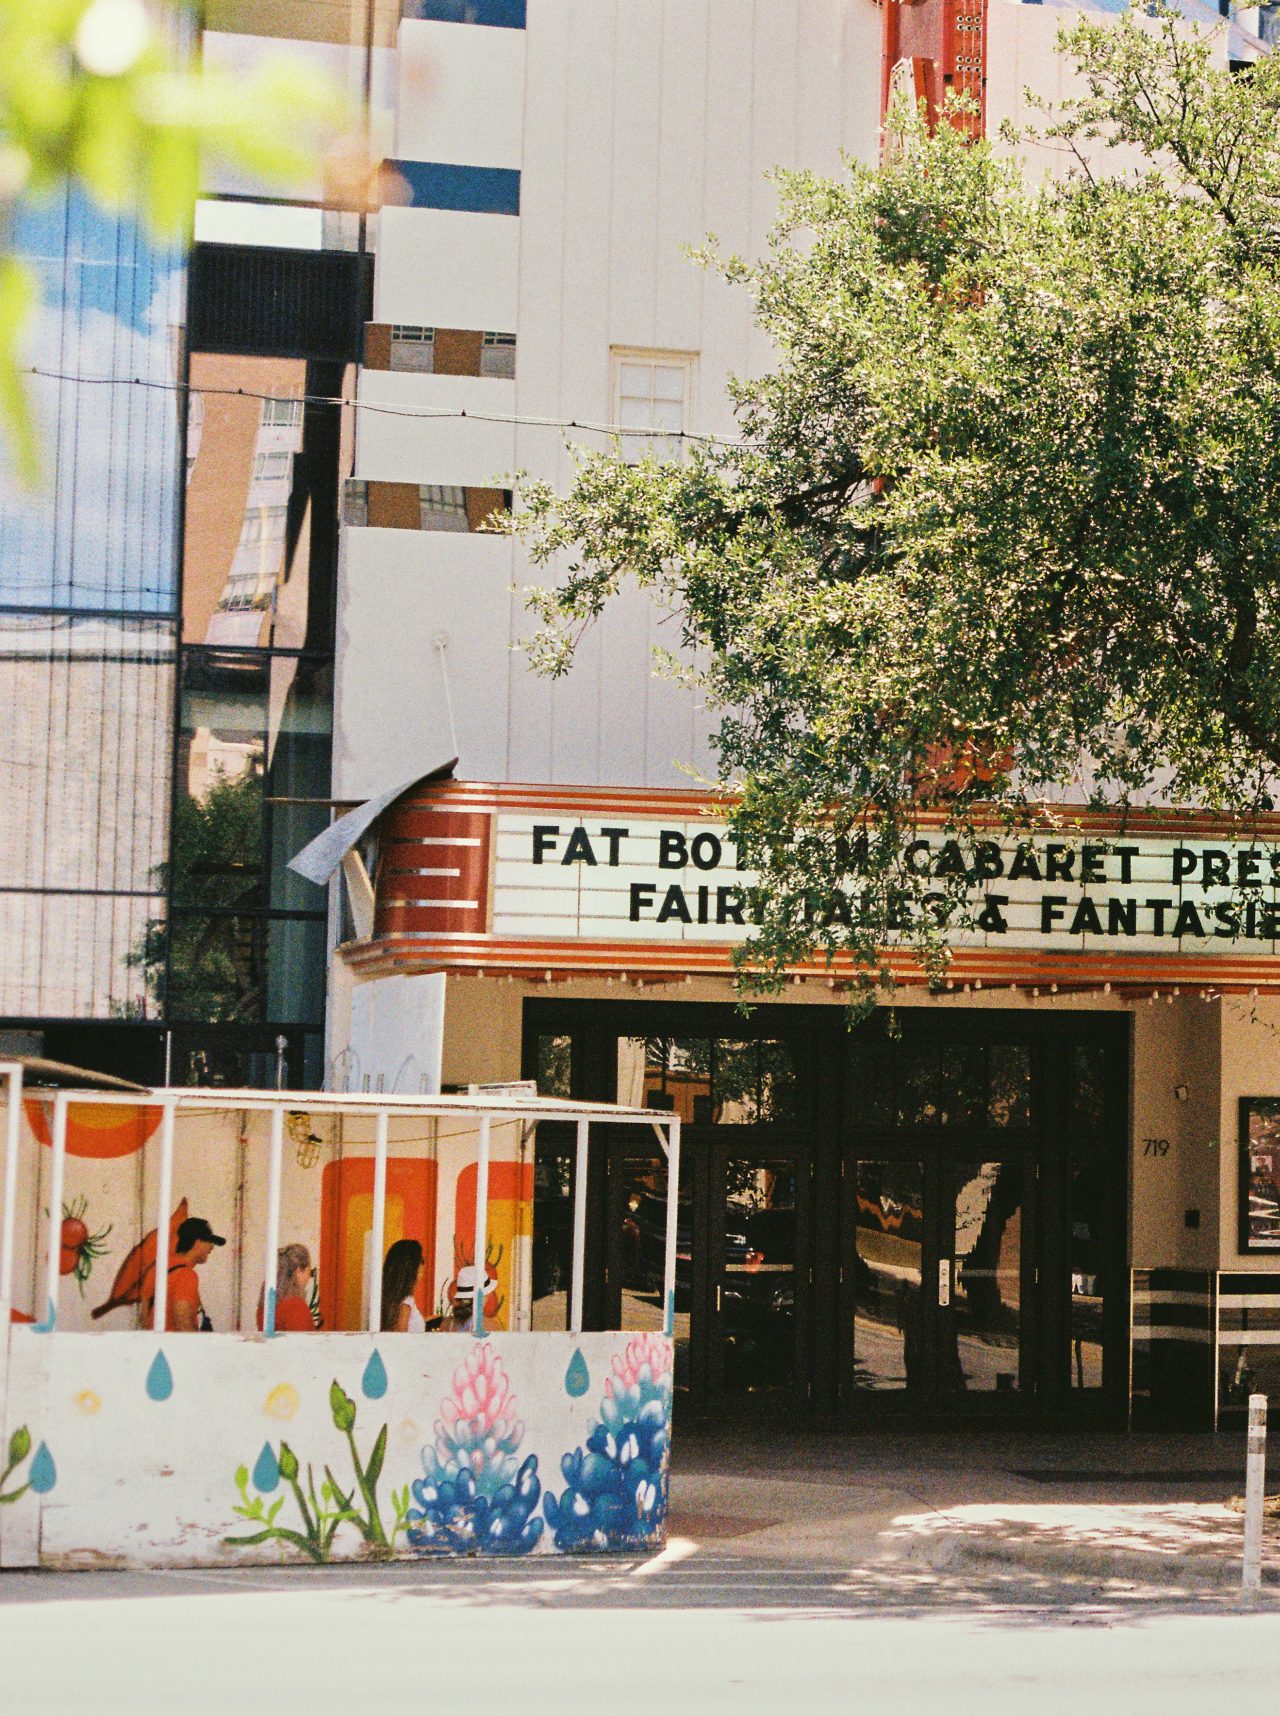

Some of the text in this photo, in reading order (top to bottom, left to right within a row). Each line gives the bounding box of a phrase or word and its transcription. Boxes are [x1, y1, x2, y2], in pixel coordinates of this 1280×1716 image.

[532, 825, 629, 866] FAT
[659, 830, 869, 876] BOTTM
[904, 839, 1139, 885] CABARET
[978, 895, 1009, 934] &
[1143, 1139, 1170, 1158] 719
